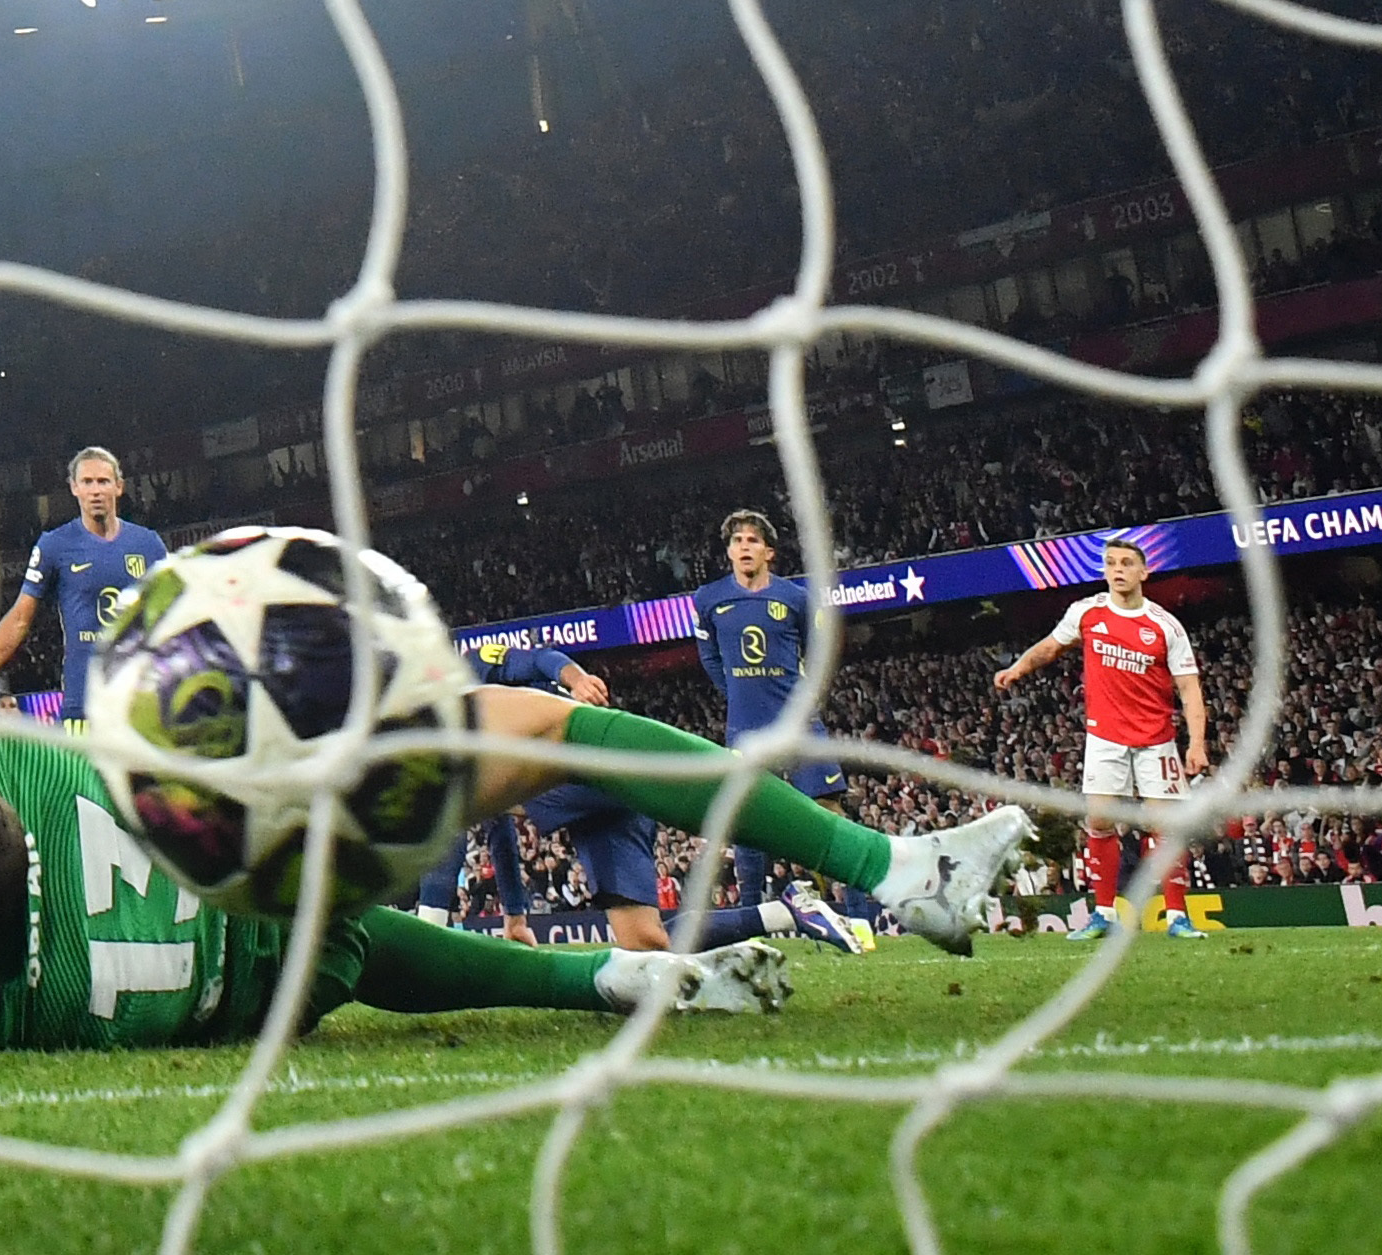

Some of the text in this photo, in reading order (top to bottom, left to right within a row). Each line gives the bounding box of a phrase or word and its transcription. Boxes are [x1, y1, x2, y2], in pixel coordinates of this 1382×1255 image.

[1111, 192, 1176, 230] 2003
[848, 262, 900, 296] 2002
[620, 429, 684, 466] Arsenal
[1231, 517, 1301, 549] UEFA
[1091, 638, 1157, 666] Emirates
[1157, 755, 1181, 782] 19
